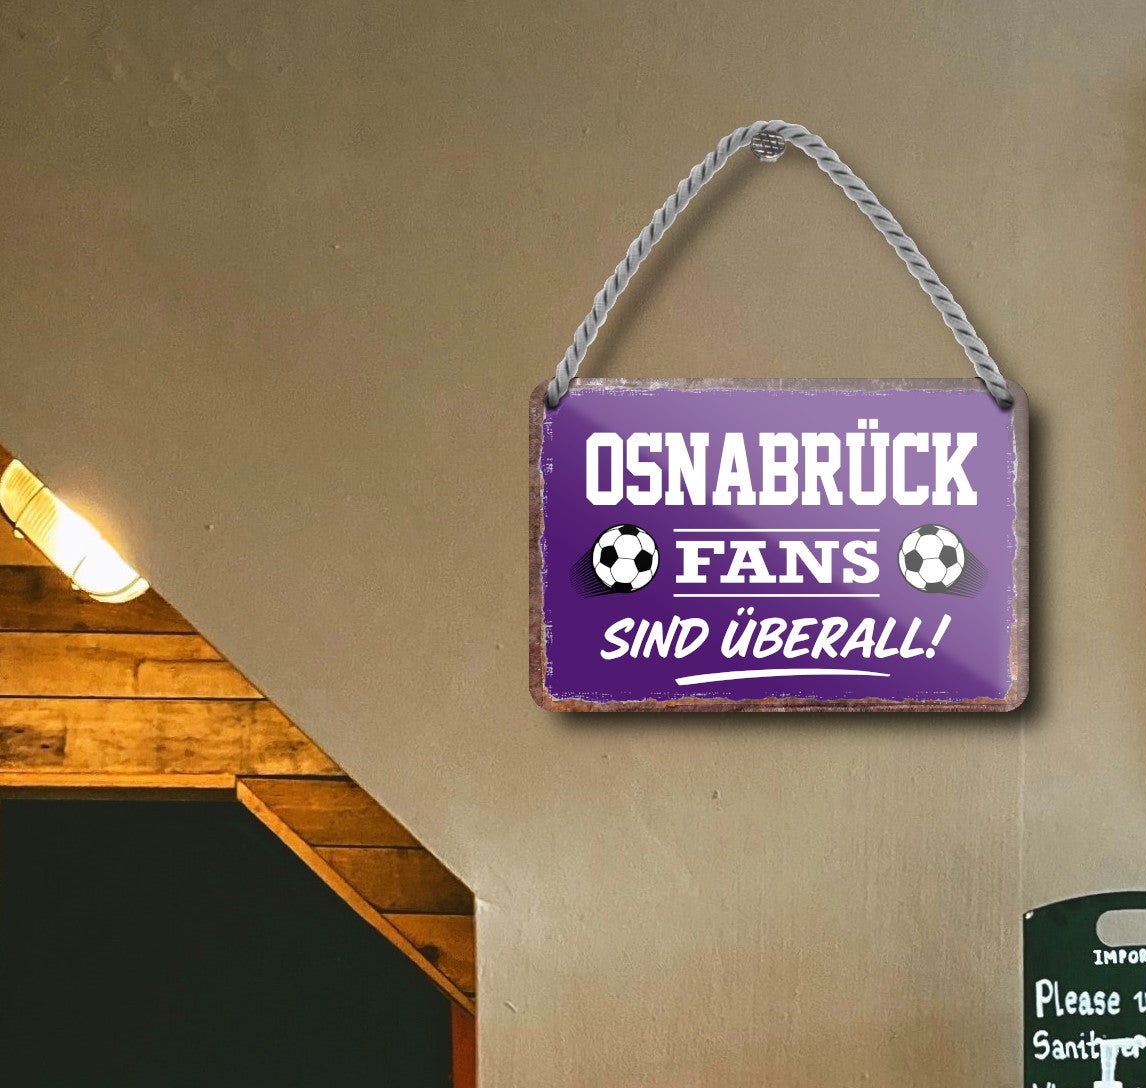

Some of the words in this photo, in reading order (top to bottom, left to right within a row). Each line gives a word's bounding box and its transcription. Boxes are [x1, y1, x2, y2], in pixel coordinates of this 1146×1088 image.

[585, 418, 978, 506] OSNABRÜCK
[675, 539, 880, 584] FANS
[600, 614, 710, 661] SIND
[719, 606, 952, 660] ÜBERALL!
[1035, 978, 1121, 1018] Please
[1032, 1029, 1142, 1061] Saniter
